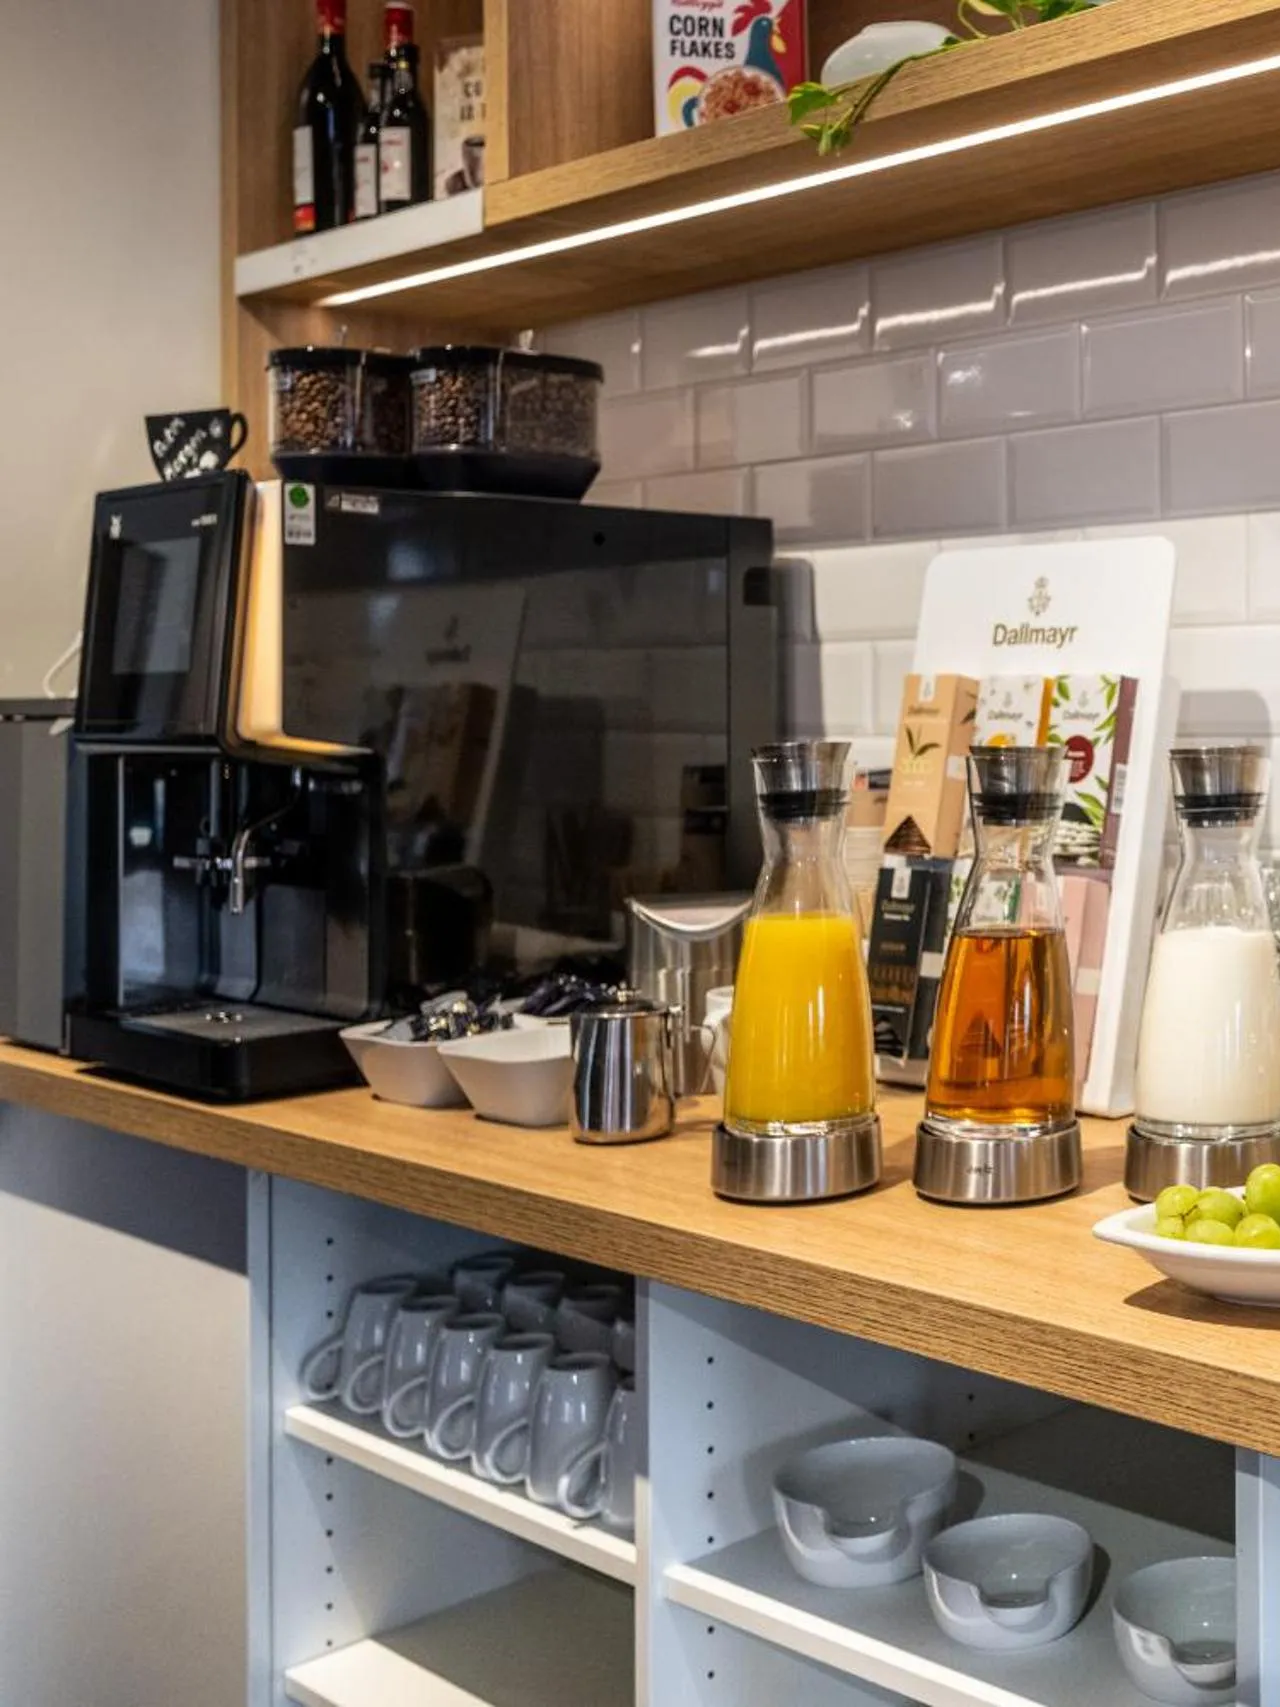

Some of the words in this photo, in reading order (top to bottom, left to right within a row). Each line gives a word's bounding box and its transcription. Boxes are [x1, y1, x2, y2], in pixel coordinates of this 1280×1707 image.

[669, 15, 724, 37] CORN
[670, 40, 735, 59] FLAKES
[993, 622, 1077, 648] Dallmayr
